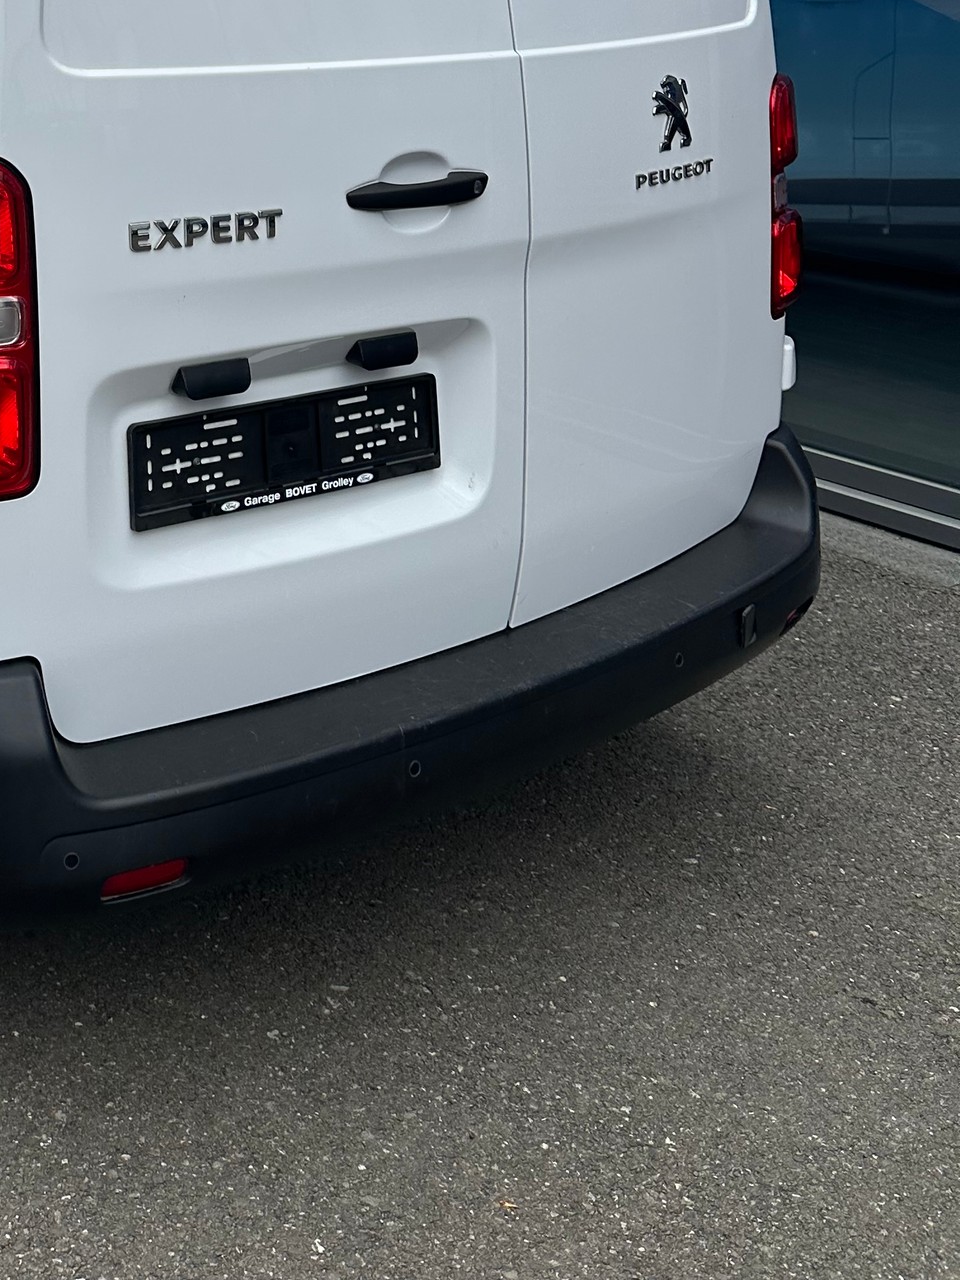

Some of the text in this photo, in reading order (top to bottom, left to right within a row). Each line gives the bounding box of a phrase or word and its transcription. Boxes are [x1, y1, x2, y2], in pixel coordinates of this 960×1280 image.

[635, 157, 715, 190] PEUGEOT
[127, 207, 284, 254] EXPERT
[244, 492, 281, 507] Garage
[285, 483, 318, 499] BOVET
[321, 477, 354, 491] Grolley
